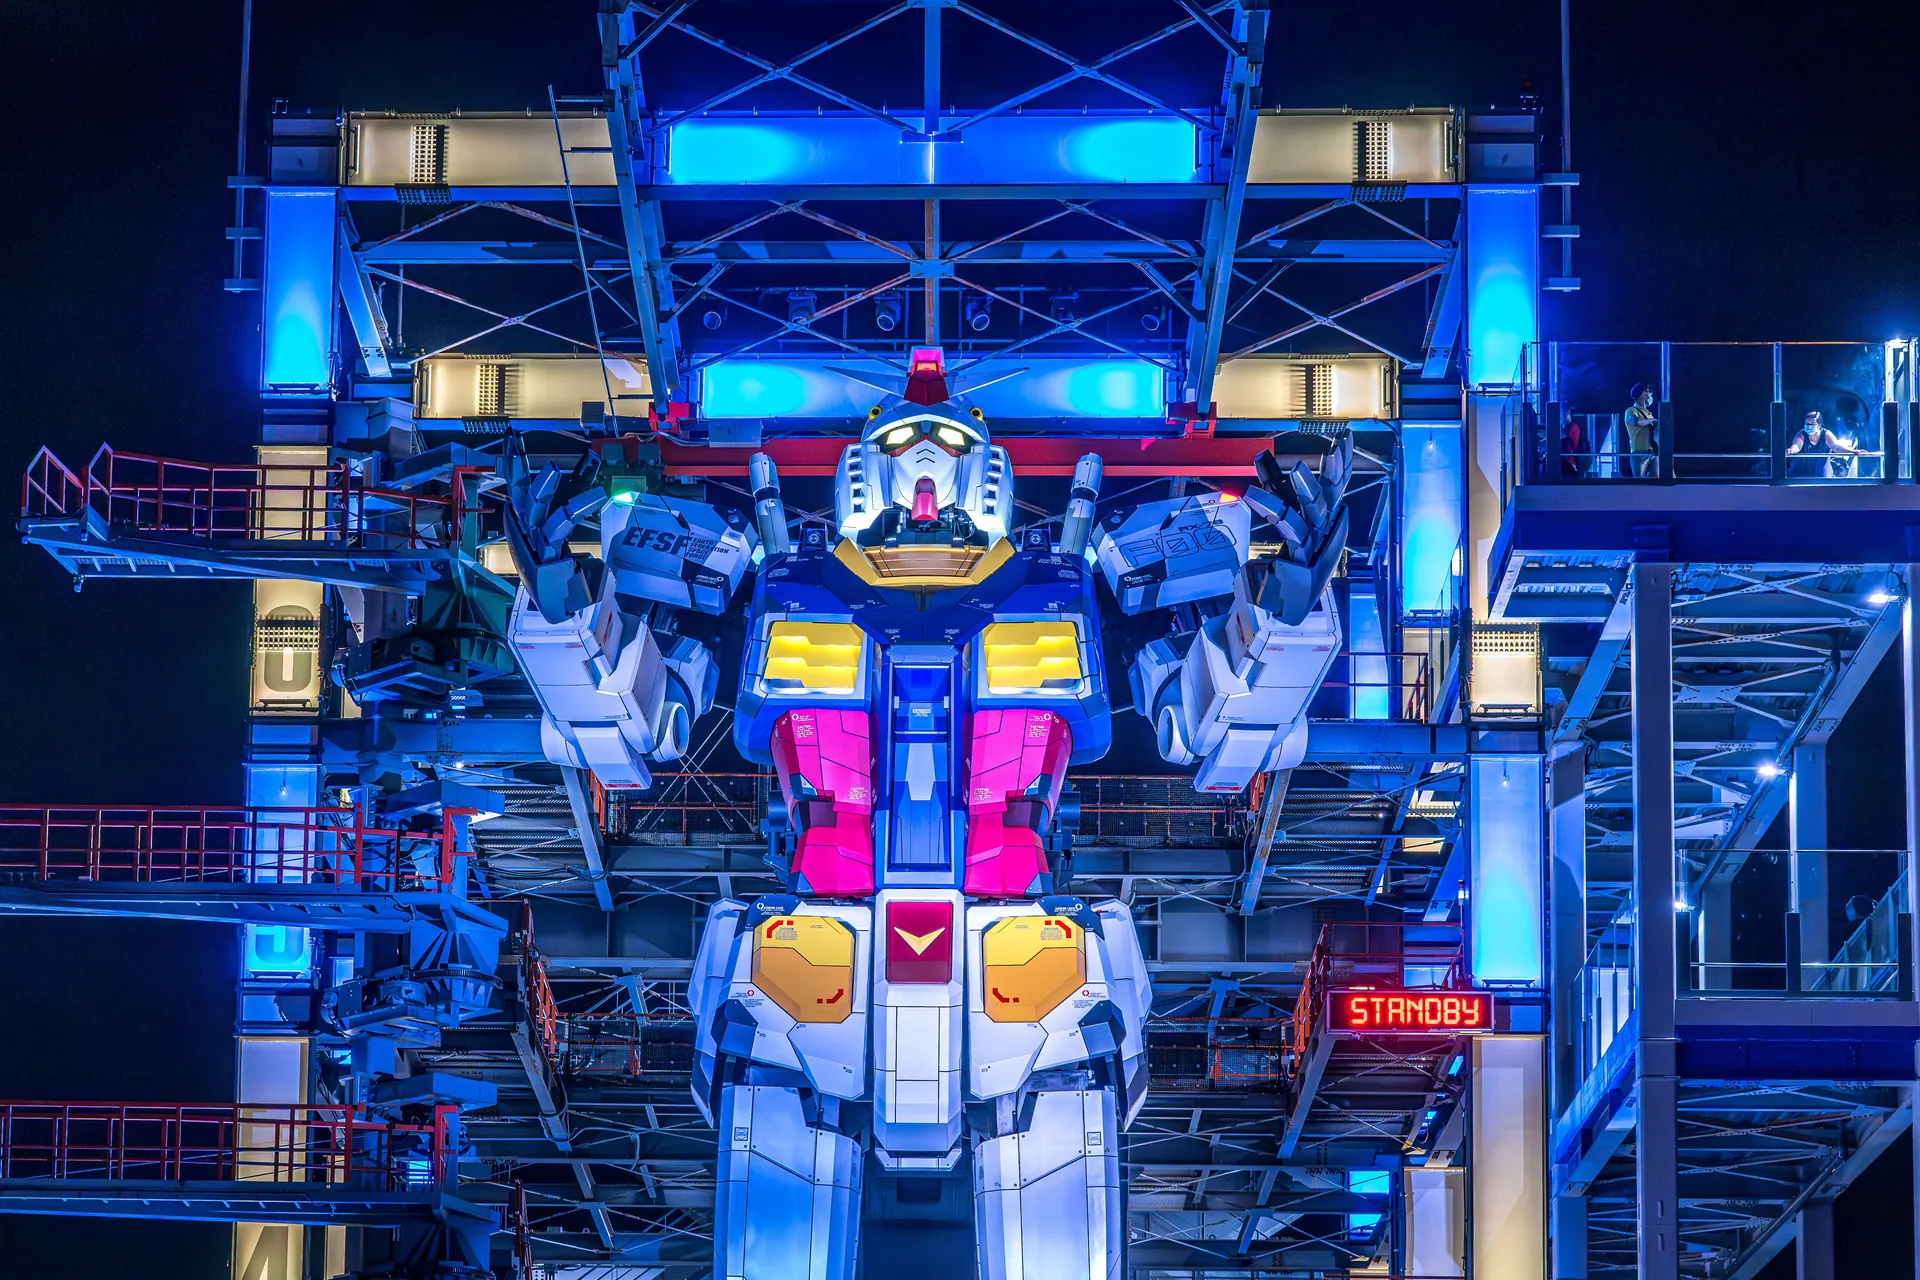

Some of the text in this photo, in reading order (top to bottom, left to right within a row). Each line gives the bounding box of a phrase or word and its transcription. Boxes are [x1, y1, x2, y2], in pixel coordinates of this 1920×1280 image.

[621, 526, 694, 555] EFSF
[692, 537, 714, 545] EARTH
[687, 547, 709, 556] SPACE
[690, 542, 730, 554] FEDERATION
[685, 551, 707, 560] FORCE
[1350, 997, 1479, 1025] STANDBY
